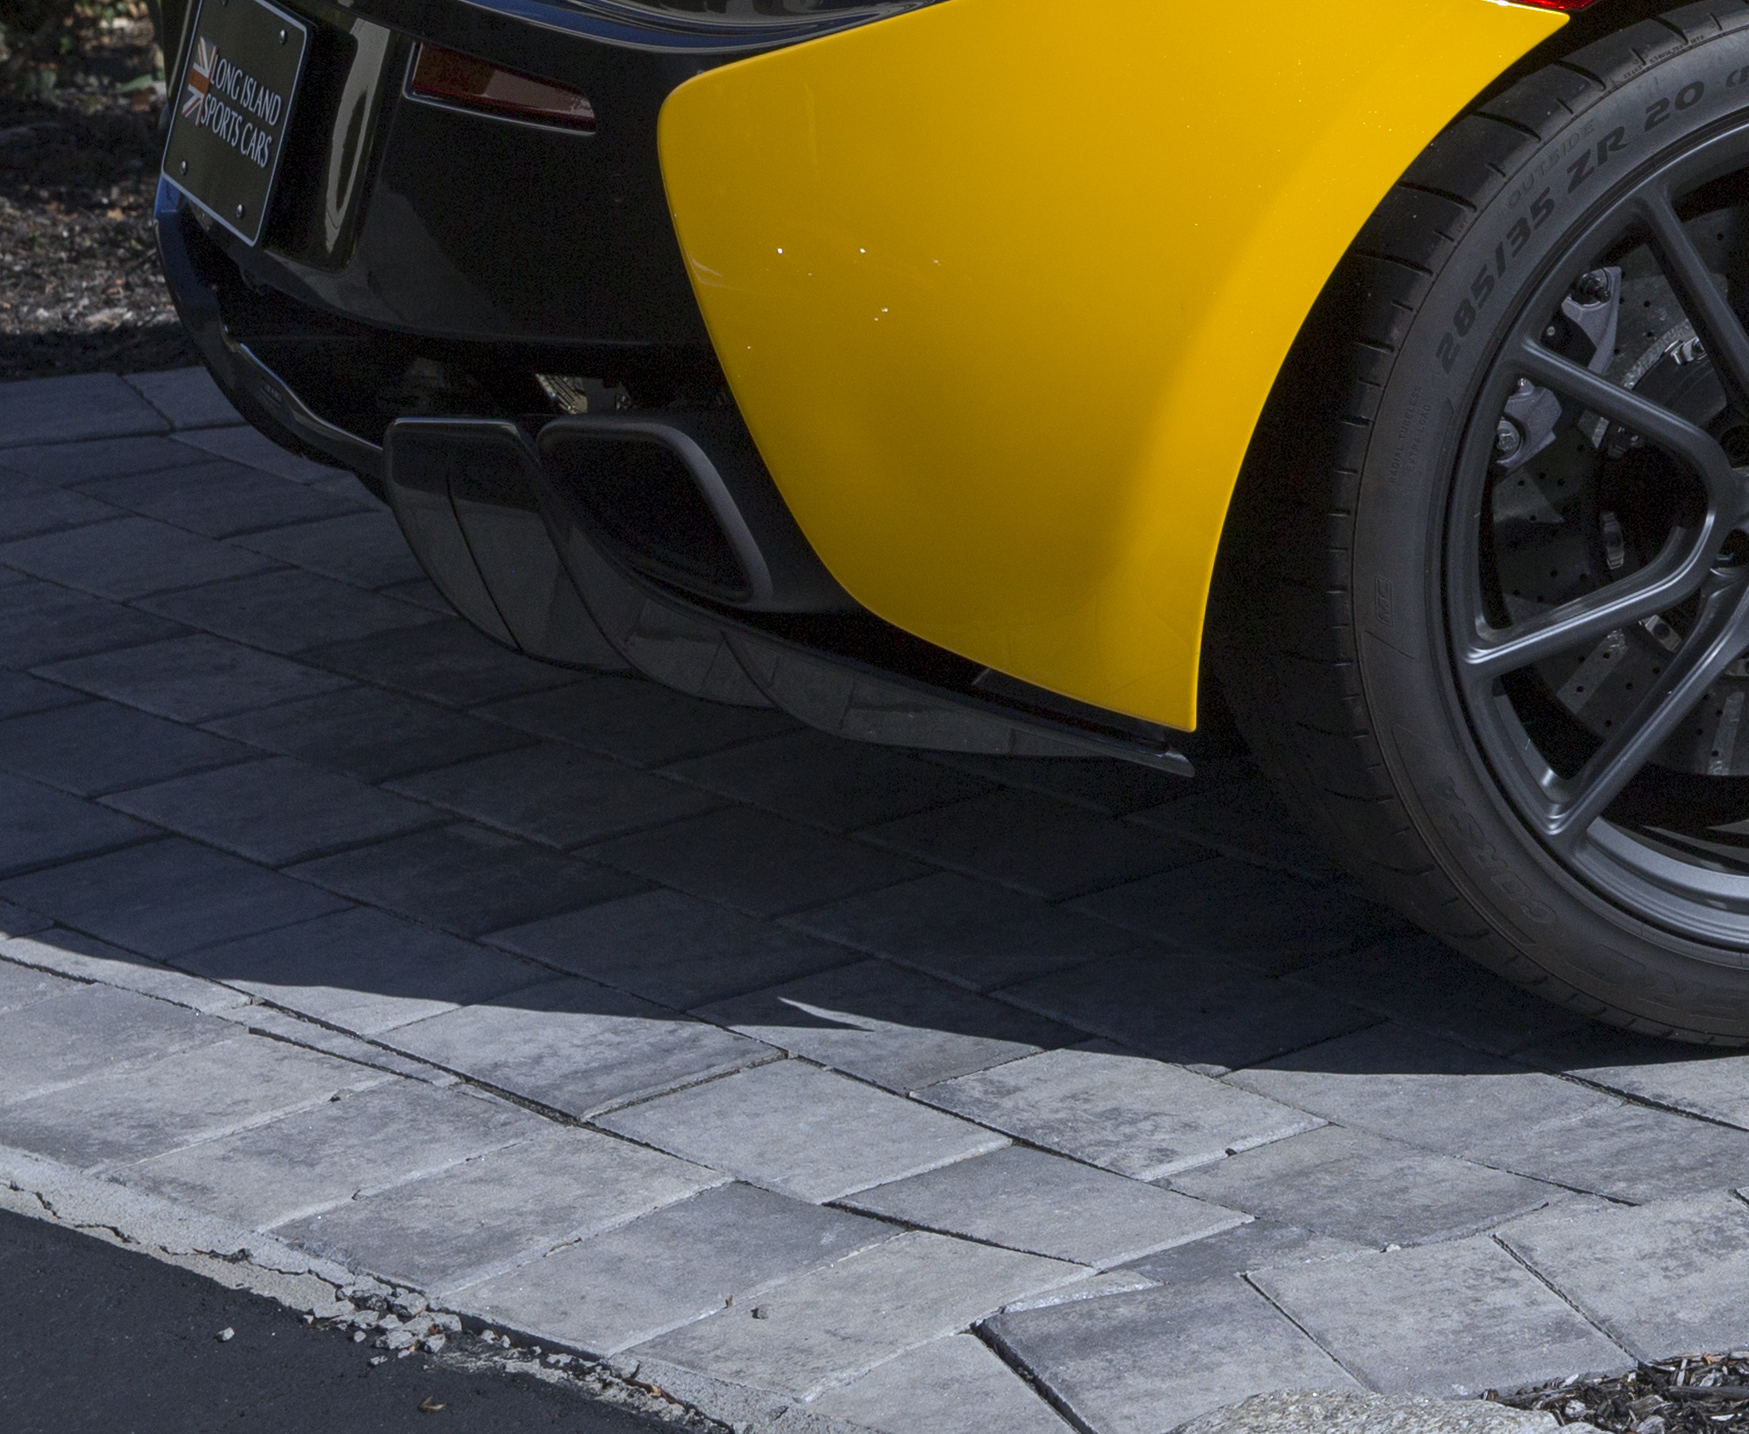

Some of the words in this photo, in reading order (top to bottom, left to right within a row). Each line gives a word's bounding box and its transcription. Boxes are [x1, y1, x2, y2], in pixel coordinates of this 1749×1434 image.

[201, 93, 243, 147] SPORTS
[241, 122, 272, 169] CARS
[210, 54, 243, 99] LONG
[240, 75, 282, 126] ISLAND
[1507, 118, 1596, 209] OUTSIDE
[1435, 186, 1556, 374] 285/35
[1566, 124, 1628, 195] ZR
[1643, 80, 1705, 132] 20
